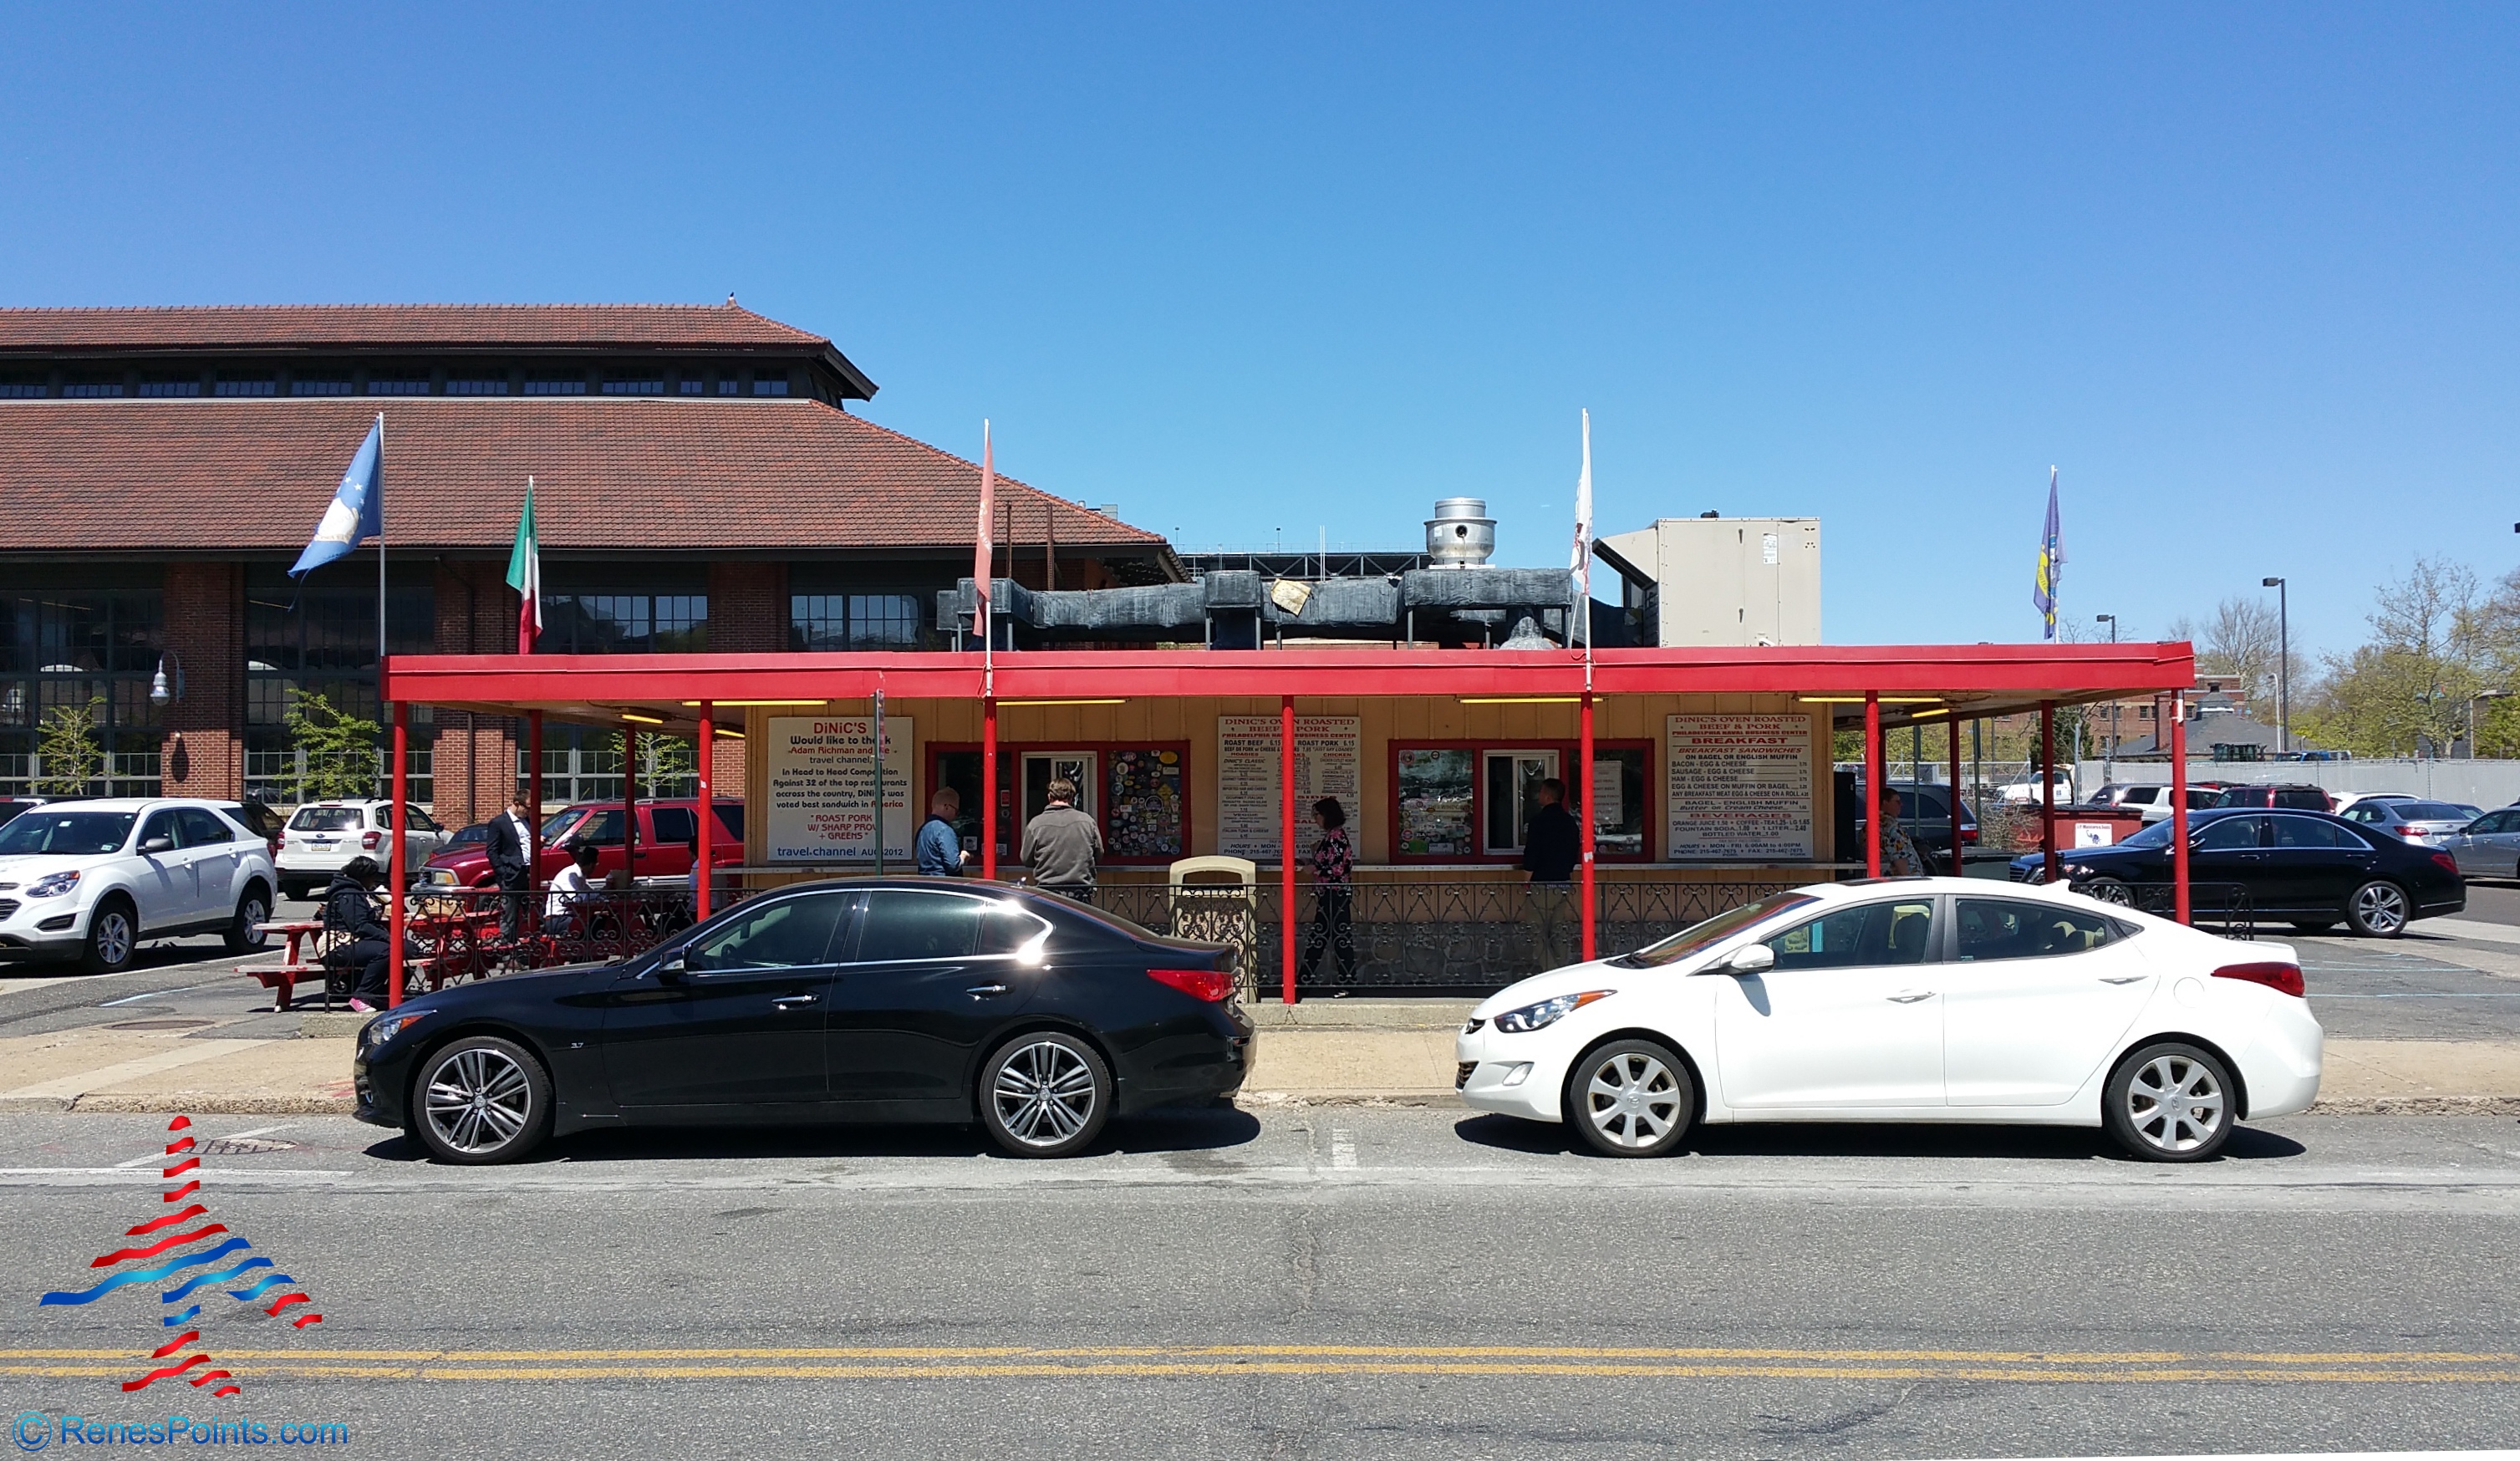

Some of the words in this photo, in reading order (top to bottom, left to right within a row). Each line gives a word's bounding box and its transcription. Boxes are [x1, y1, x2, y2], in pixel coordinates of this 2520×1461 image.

[791, 736, 823, 745] Would
[827, 736, 845, 745] like
[862, 736, 891, 745] thk
[850, 769, 899, 777] Competion
[773, 779, 804, 788] Against
